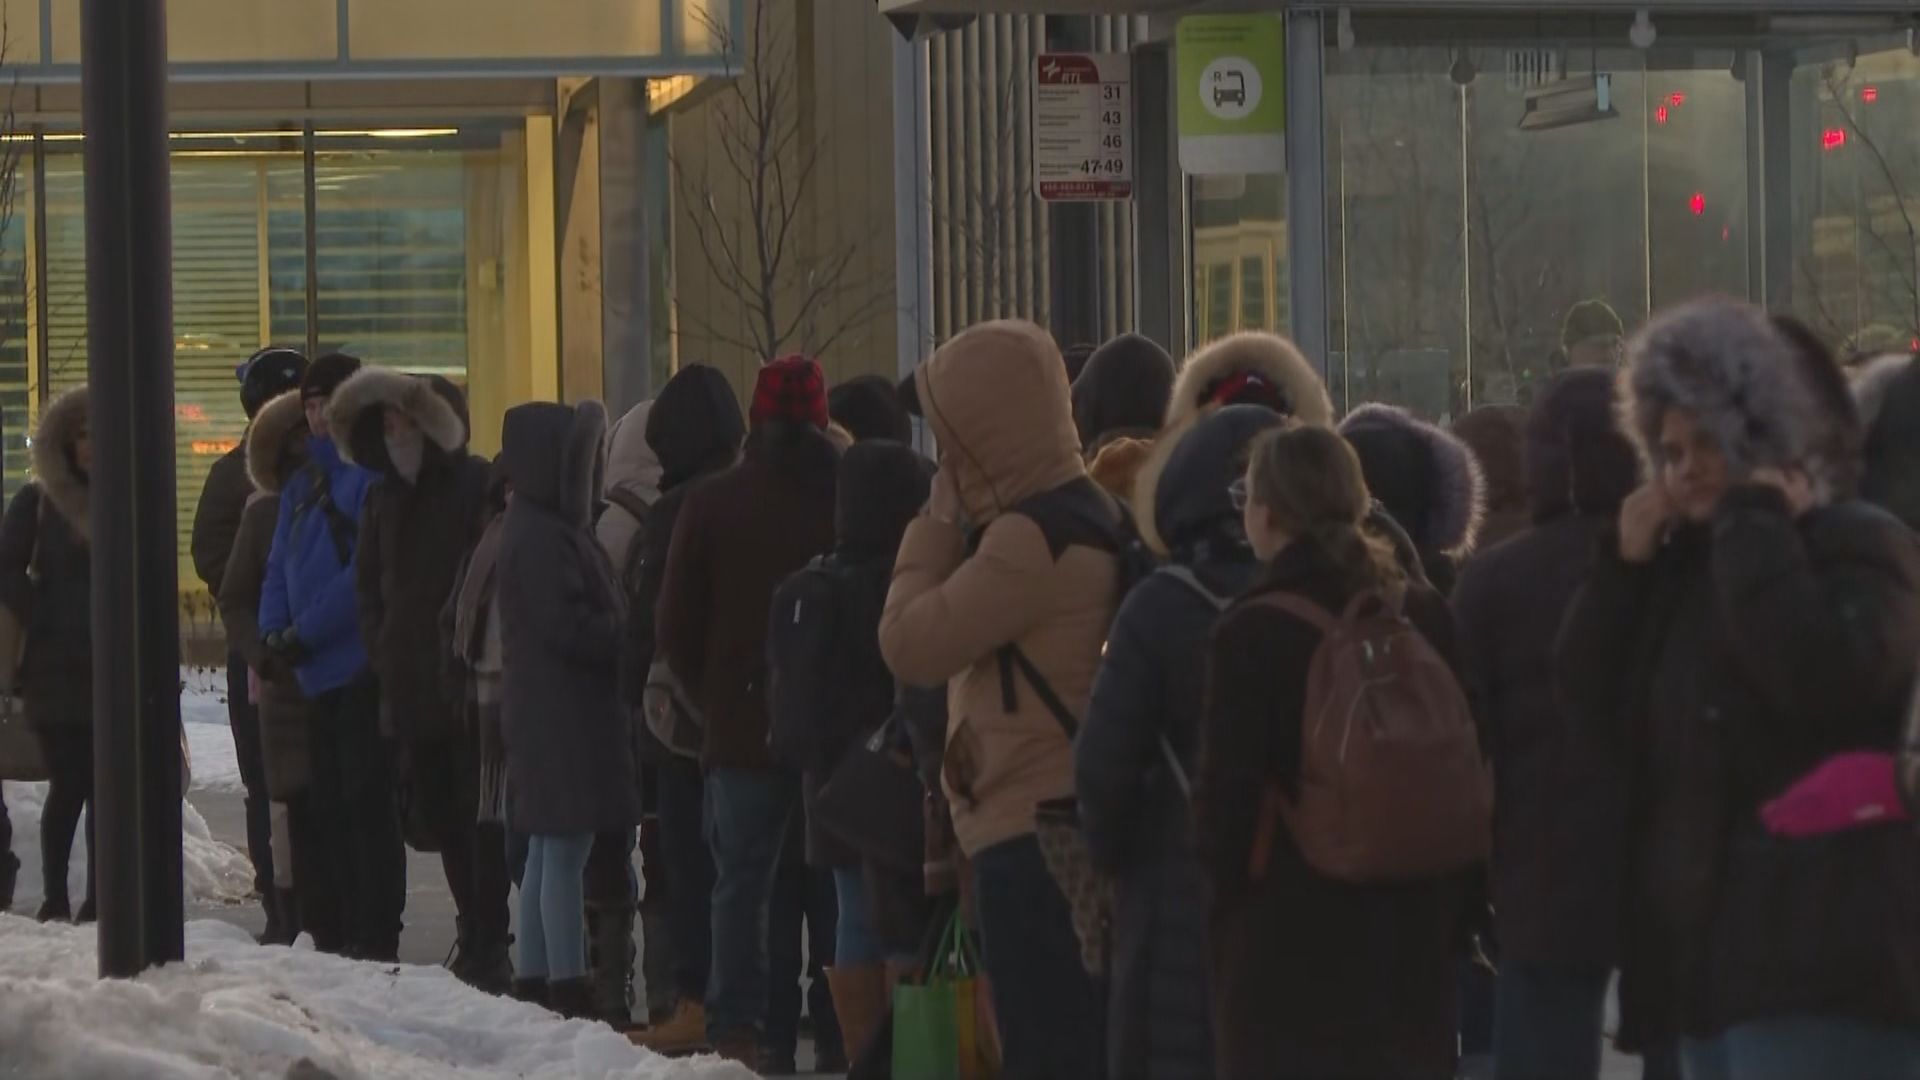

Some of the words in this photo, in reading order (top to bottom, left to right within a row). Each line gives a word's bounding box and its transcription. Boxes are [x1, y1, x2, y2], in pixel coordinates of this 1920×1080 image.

[1103, 85, 1120, 100] 31
[1102, 111, 1121, 125] 43
[1102, 135, 1122, 149] 46
